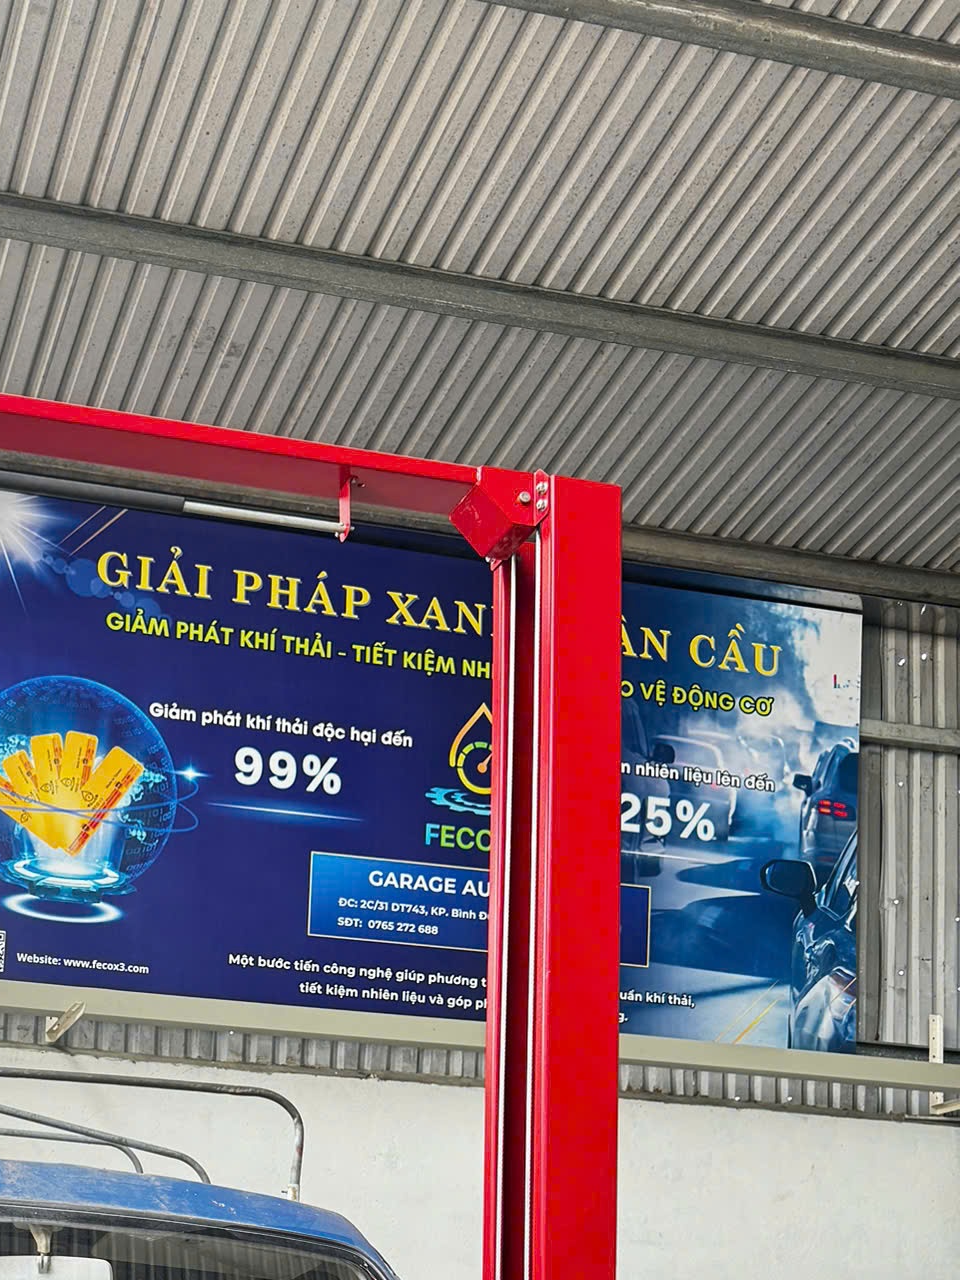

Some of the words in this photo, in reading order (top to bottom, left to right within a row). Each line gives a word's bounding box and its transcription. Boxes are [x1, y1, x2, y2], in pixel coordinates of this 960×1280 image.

[97, 546, 213, 600] GIẢI
[232, 569, 372, 620] PHÁP
[386, 590, 493, 637] XAN
[621, 614, 672, 662] ÀN
[689, 623, 783, 677] CẦU
[106, 608, 170, 638] GIẢM
[176, 619, 234, 646] PHÁT
[240, 627, 279, 652] KHÍ
[282, 632, 332, 659] THẢI
[352, 641, 398, 667] TIẾT
[403, 648, 456, 676] KIỆM
[462, 658, 492, 680] NH
[621, 681, 634, 698] O
[640, 679, 666, 708] VỆ
[672, 683, 735, 711] ĐỘNG
[739, 696, 775, 716] CƠ
[149, 702, 197, 722] Giảm
[201, 708, 241, 727] phát
[246, 713, 272, 731] khí
[275, 717, 308, 736] thải
[312, 722, 346, 743] độc
[350, 726, 377, 747] hại
[381, 729, 414, 748] đến
[234, 745, 342, 796] 99%
[635, 762, 679, 780] nhiên
[684, 768, 712, 787] liệu
[717, 771, 741, 788] lên
[744, 773, 776, 792] đến
[620, 792, 716, 842] 25%
[424, 822, 492, 852] FECO
[368, 869, 457, 895] GARAGE
[461, 878, 491, 898] AU
[338, 897, 358, 908] ĐC:
[360, 899, 389, 911] 2C/31
[391, 902, 429, 916] DT743,
[431, 906, 449, 918] KP.
[451, 908, 476, 920] Bình
[478, 910, 490, 921] Đ
[337, 916, 363, 928] SĐT:
[367, 919, 394, 931] 0765
[396, 922, 416, 933] 272
[418, 924, 439, 935] 688
[16, 952, 62, 966] Website:
[63, 958, 150, 974] www.fecox3.com
[228, 953, 255, 968] Một
[257, 955, 291, 970] bước
[294, 959, 320, 973] tiến
[323, 962, 356, 978] công
[359, 965, 392, 981] nghệ
[395, 968, 425, 984] giúp
[428, 971, 478, 988] phương
[645, 992, 665, 1003] khí
[668, 994, 695, 1008] thải,
[299, 981, 323, 995] tiết
[325, 983, 359, 998] kiệm
[362, 987, 399, 1001] nhiên
[402, 990, 426, 1005] liệu
[429, 993, 444, 1005] và
[447, 994, 473, 1011] góp
